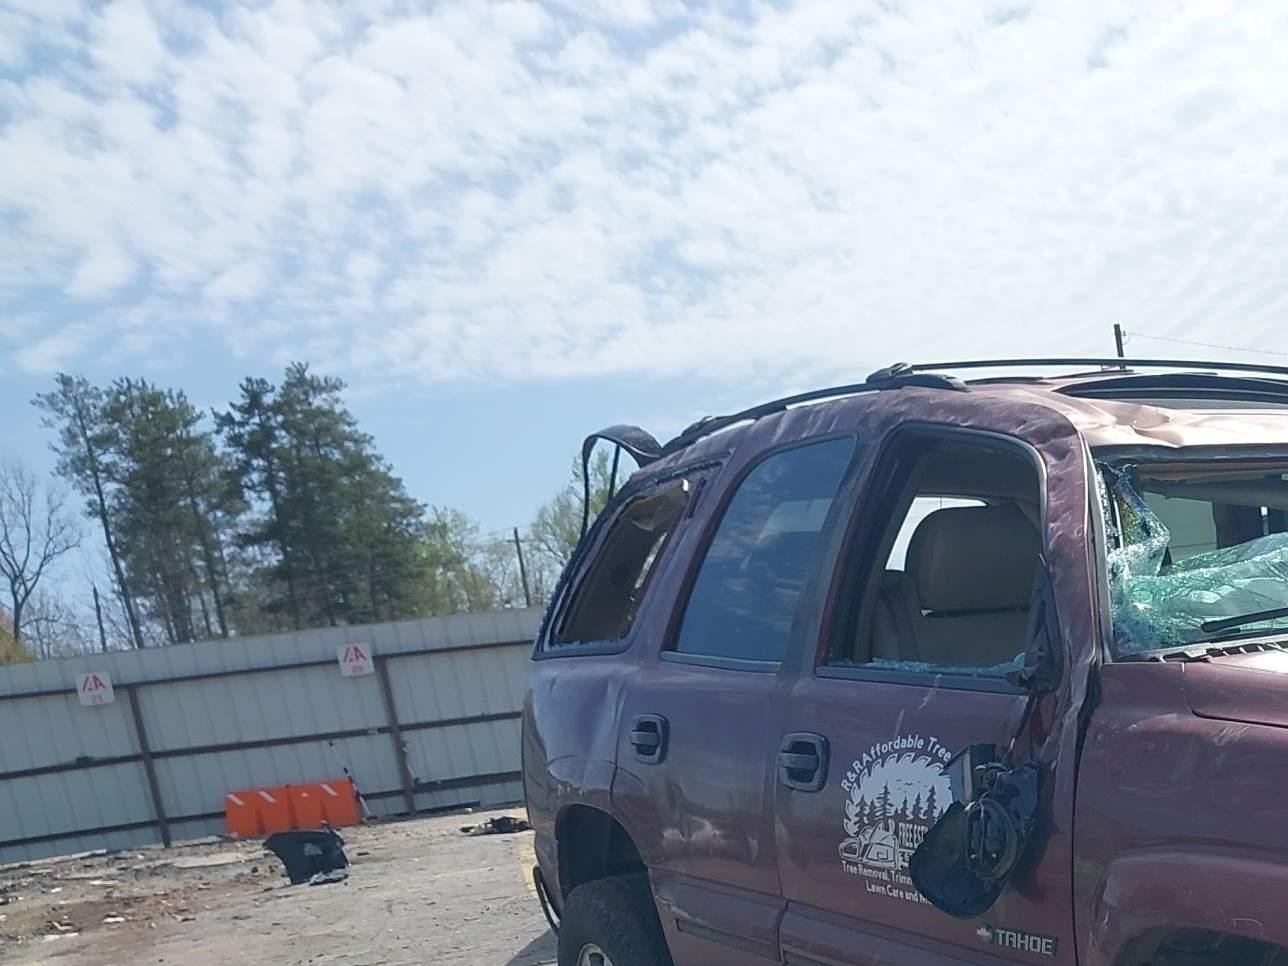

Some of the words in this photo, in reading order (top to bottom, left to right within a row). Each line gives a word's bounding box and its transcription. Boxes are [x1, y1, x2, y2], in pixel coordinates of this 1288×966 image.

[929, 737, 952, 761] Tree
[842, 860, 858, 874] Tree
[866, 880, 886, 895] Lawn
[887, 885, 904, 899] Care
[905, 890, 918, 902] and
[995, 929, 1053, 956] TAHOE
